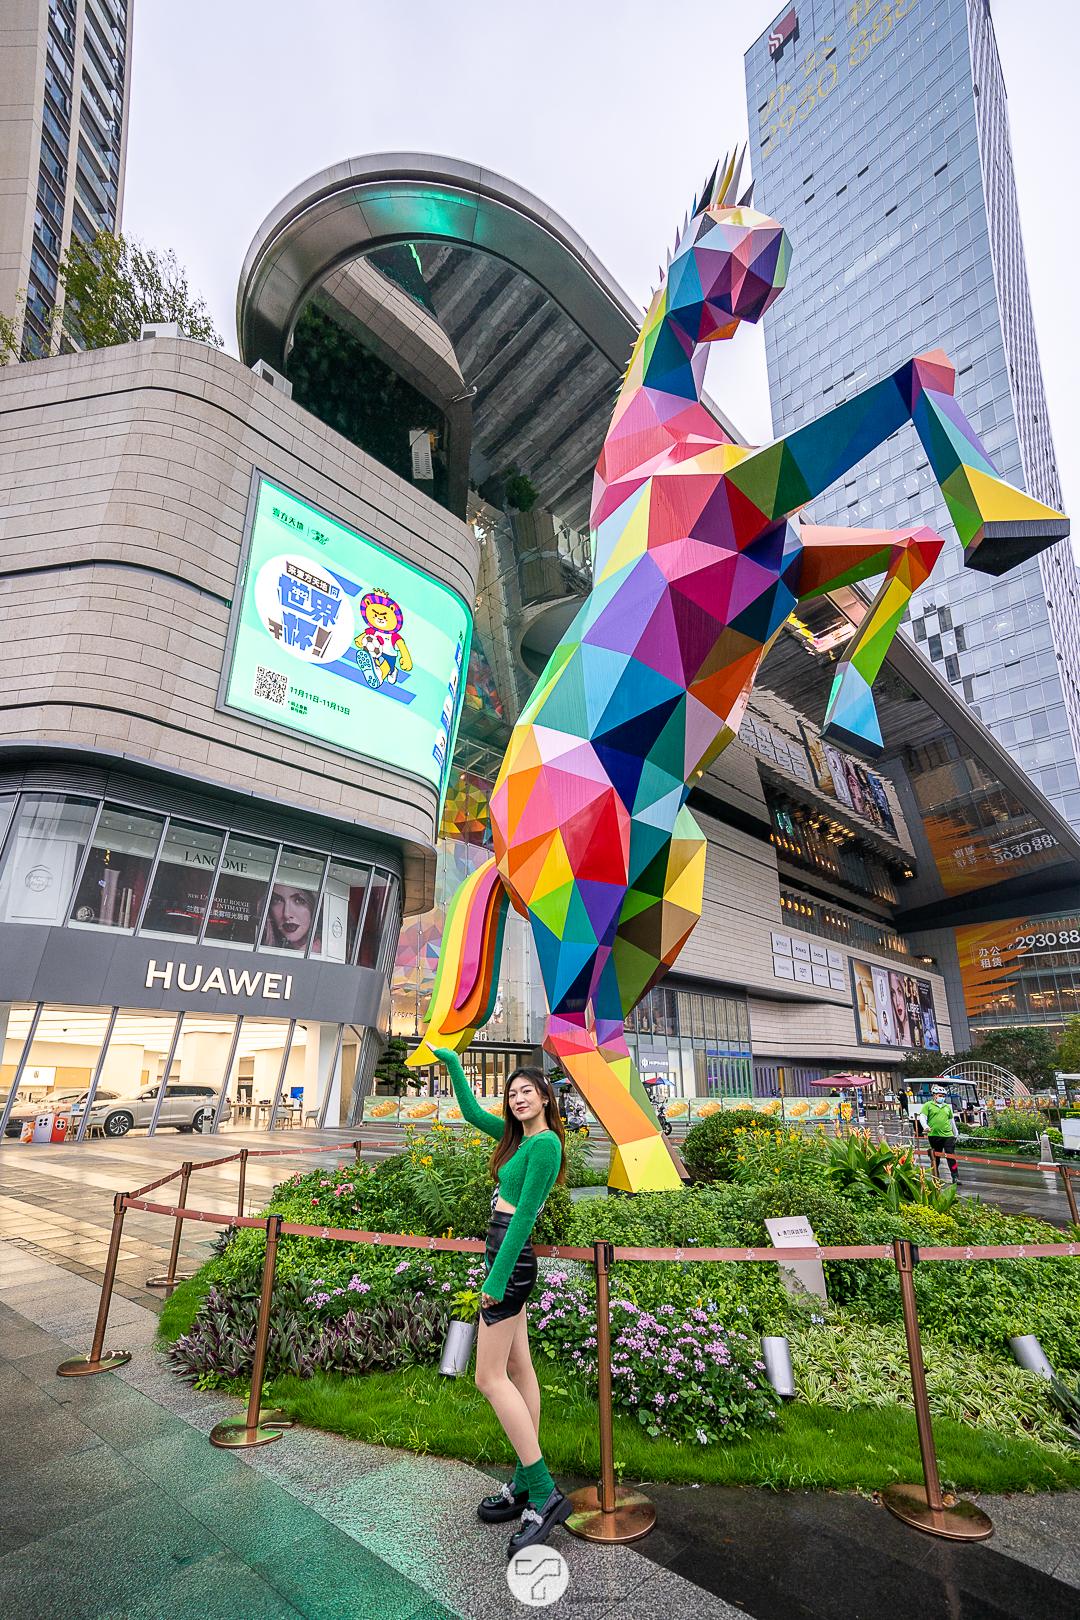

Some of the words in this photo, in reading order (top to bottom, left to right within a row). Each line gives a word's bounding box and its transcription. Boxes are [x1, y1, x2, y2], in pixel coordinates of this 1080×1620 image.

[290, 686, 351, 716] 11月11日-11月13日
[1015, 932, 1058, 950] 2930
[1058, 929, 1080, 945] 88
[979, 945, 1001, 957] 办公
[981, 956, 1003, 969] 租赁
[145, 959, 294, 1001] HUAWEI
